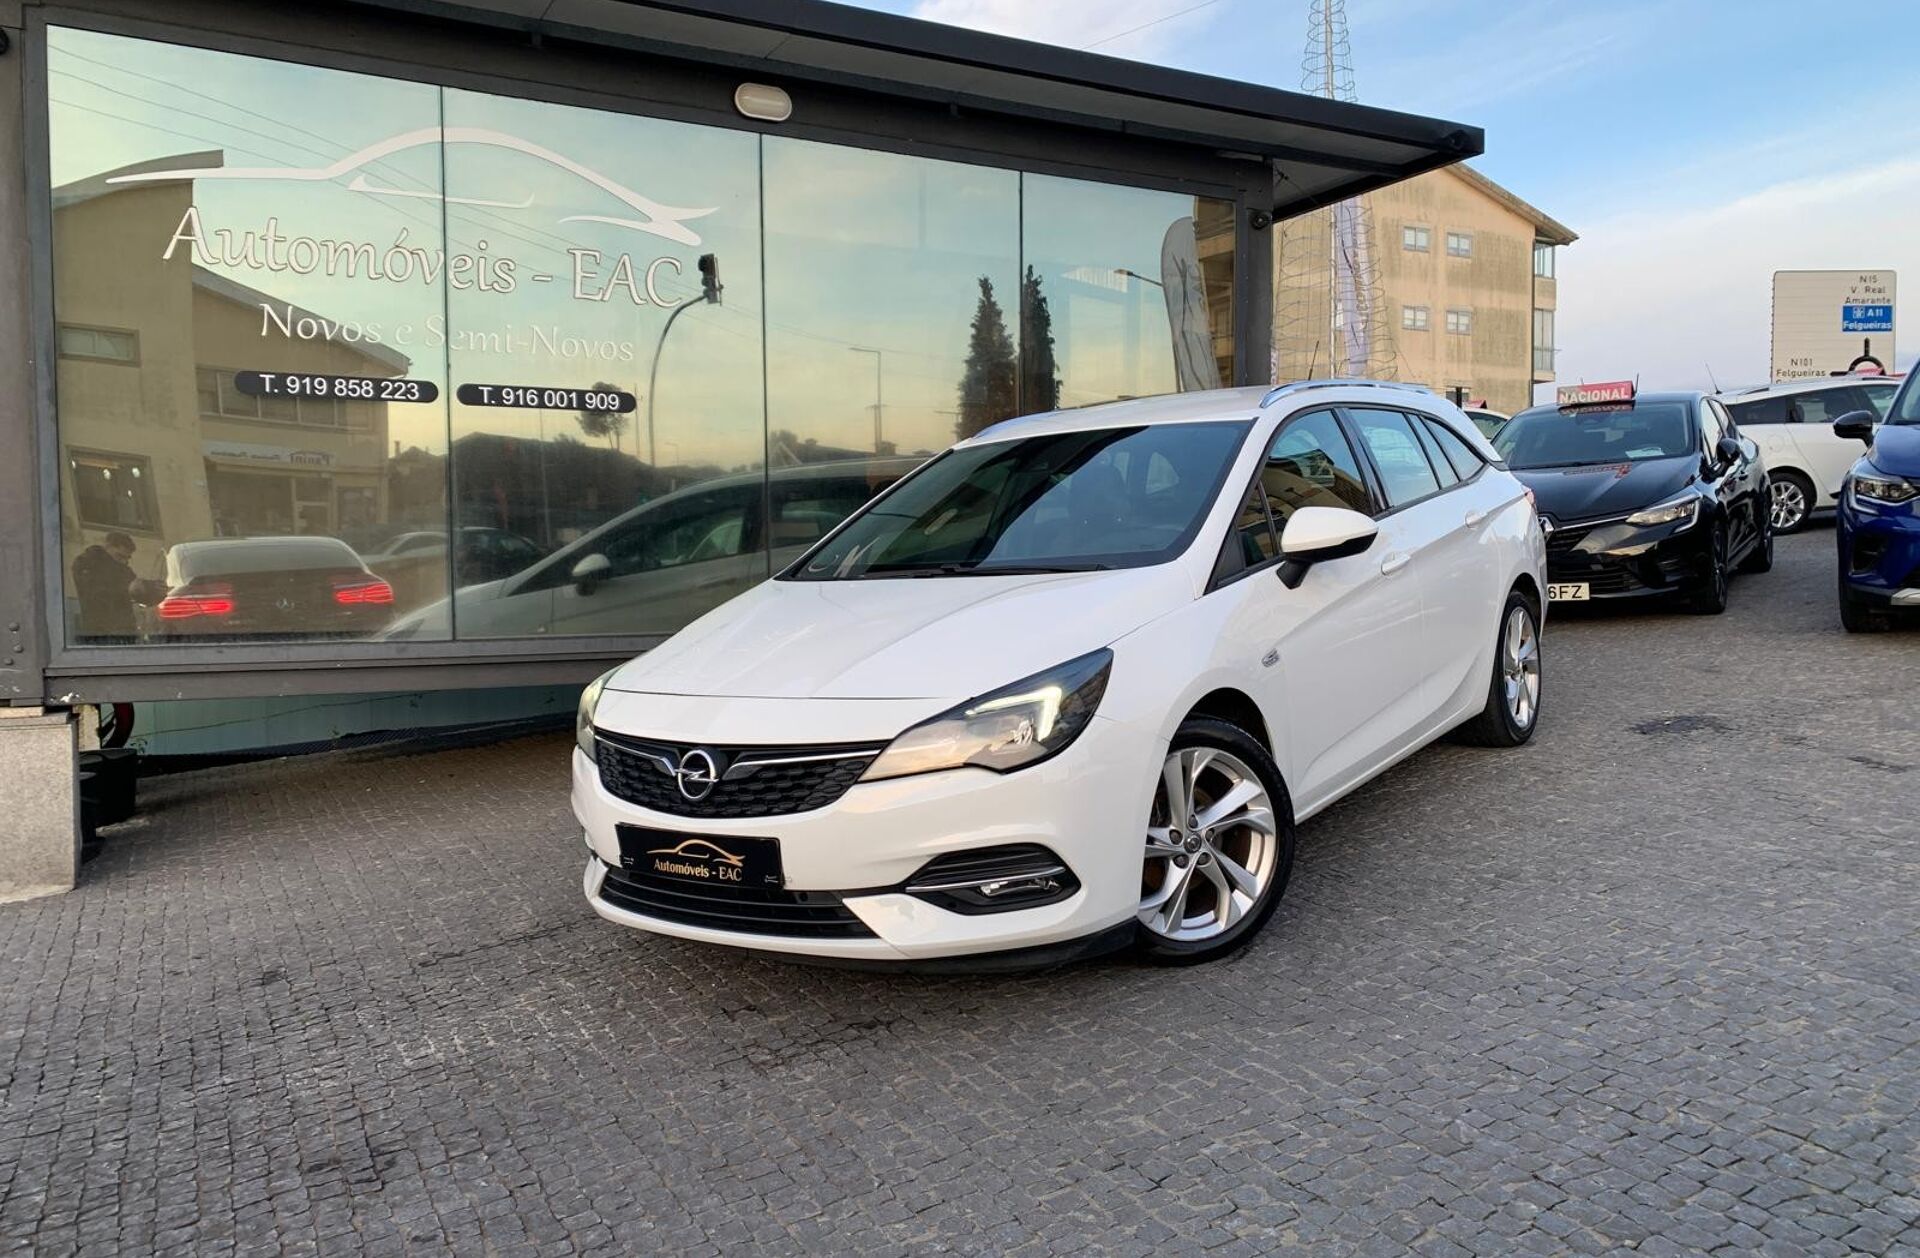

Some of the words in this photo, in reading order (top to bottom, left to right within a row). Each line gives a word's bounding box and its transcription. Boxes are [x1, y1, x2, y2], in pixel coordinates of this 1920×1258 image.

[163, 206, 516, 294] Automóveis
[567, 247, 682, 308] EAC
[1864, 285, 1886, 294] Real
[1845, 297, 1891, 305] Amarante
[260, 303, 382, 344] Novos
[395, 322, 413, 345] e
[425, 314, 634, 362] Semi-Novos
[1843, 320, 1892, 331] Felgueiras
[1776, 369, 1826, 378] Felgueiras
[259, 373, 279, 394] T.
[286, 376, 327, 396] 919
[334, 379, 374, 398] 858
[380, 382, 420, 400] 223
[478, 386, 496, 404] T.
[502, 388, 539, 406] 916
[544, 391, 577, 409] 001
[585, 393, 620, 410] 909
[1559, 387, 1629, 404] NACIONAL
[1548, 585, 1583, 600] 6FZ
[653, 858, 710, 878] Automóveis
[719, 866, 743, 882] EAC
